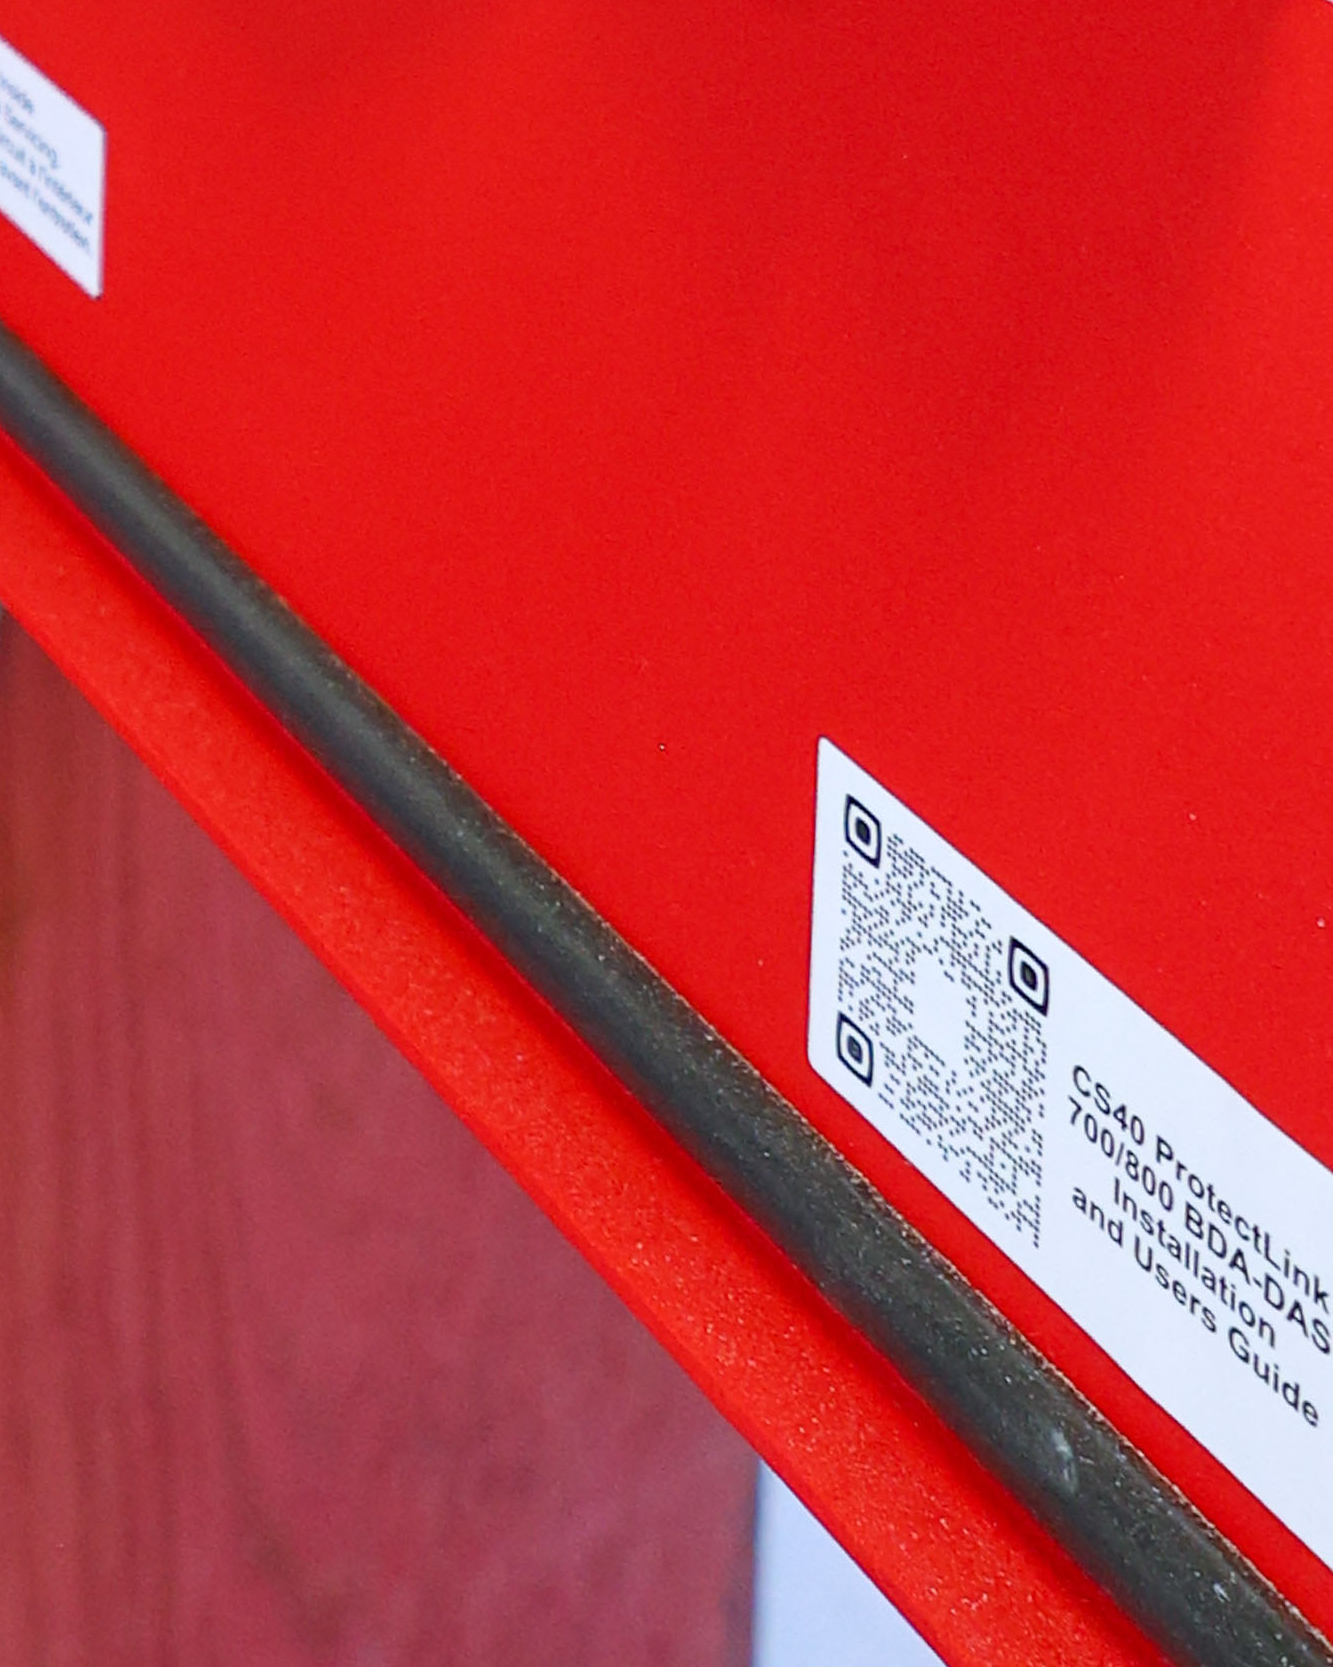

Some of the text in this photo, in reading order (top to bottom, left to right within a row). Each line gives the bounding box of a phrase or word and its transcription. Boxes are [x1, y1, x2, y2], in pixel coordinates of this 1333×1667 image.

[1067, 1096, 1332, 1356] 700/800 BDA-DAS
[1071, 1187, 1319, 1428] and Users Guide
[1072, 1064, 1331, 1315] CS40 ProtectLink
[1113, 1177, 1276, 1349] Installation
